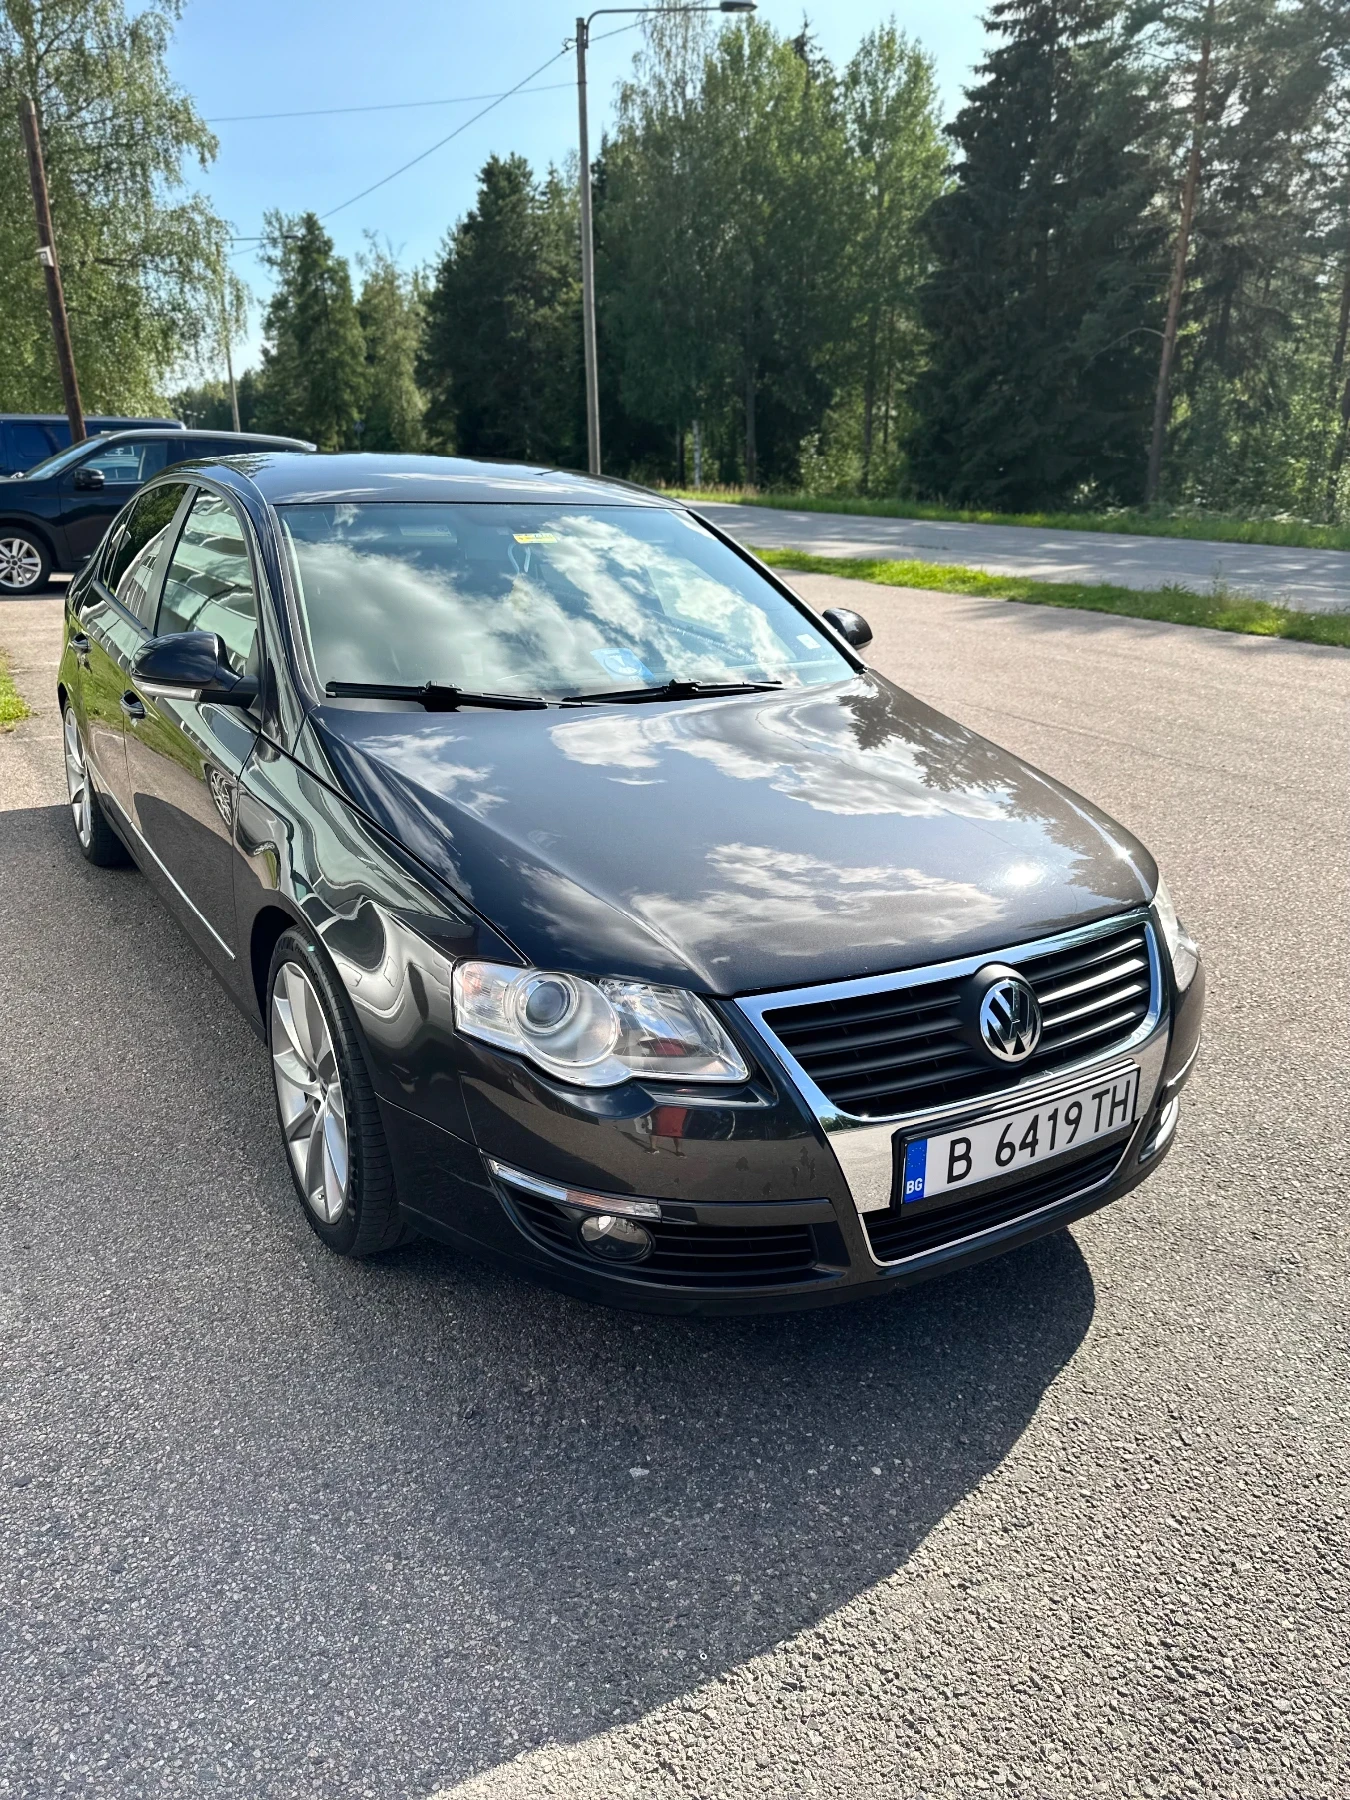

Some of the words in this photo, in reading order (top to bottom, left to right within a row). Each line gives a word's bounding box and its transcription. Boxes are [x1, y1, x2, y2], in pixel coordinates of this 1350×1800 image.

[946, 1136, 973, 1184] B
[995, 1100, 1082, 1167] 6419
[1091, 1079, 1131, 1133] TH
[906, 1177, 923, 1195] BG
